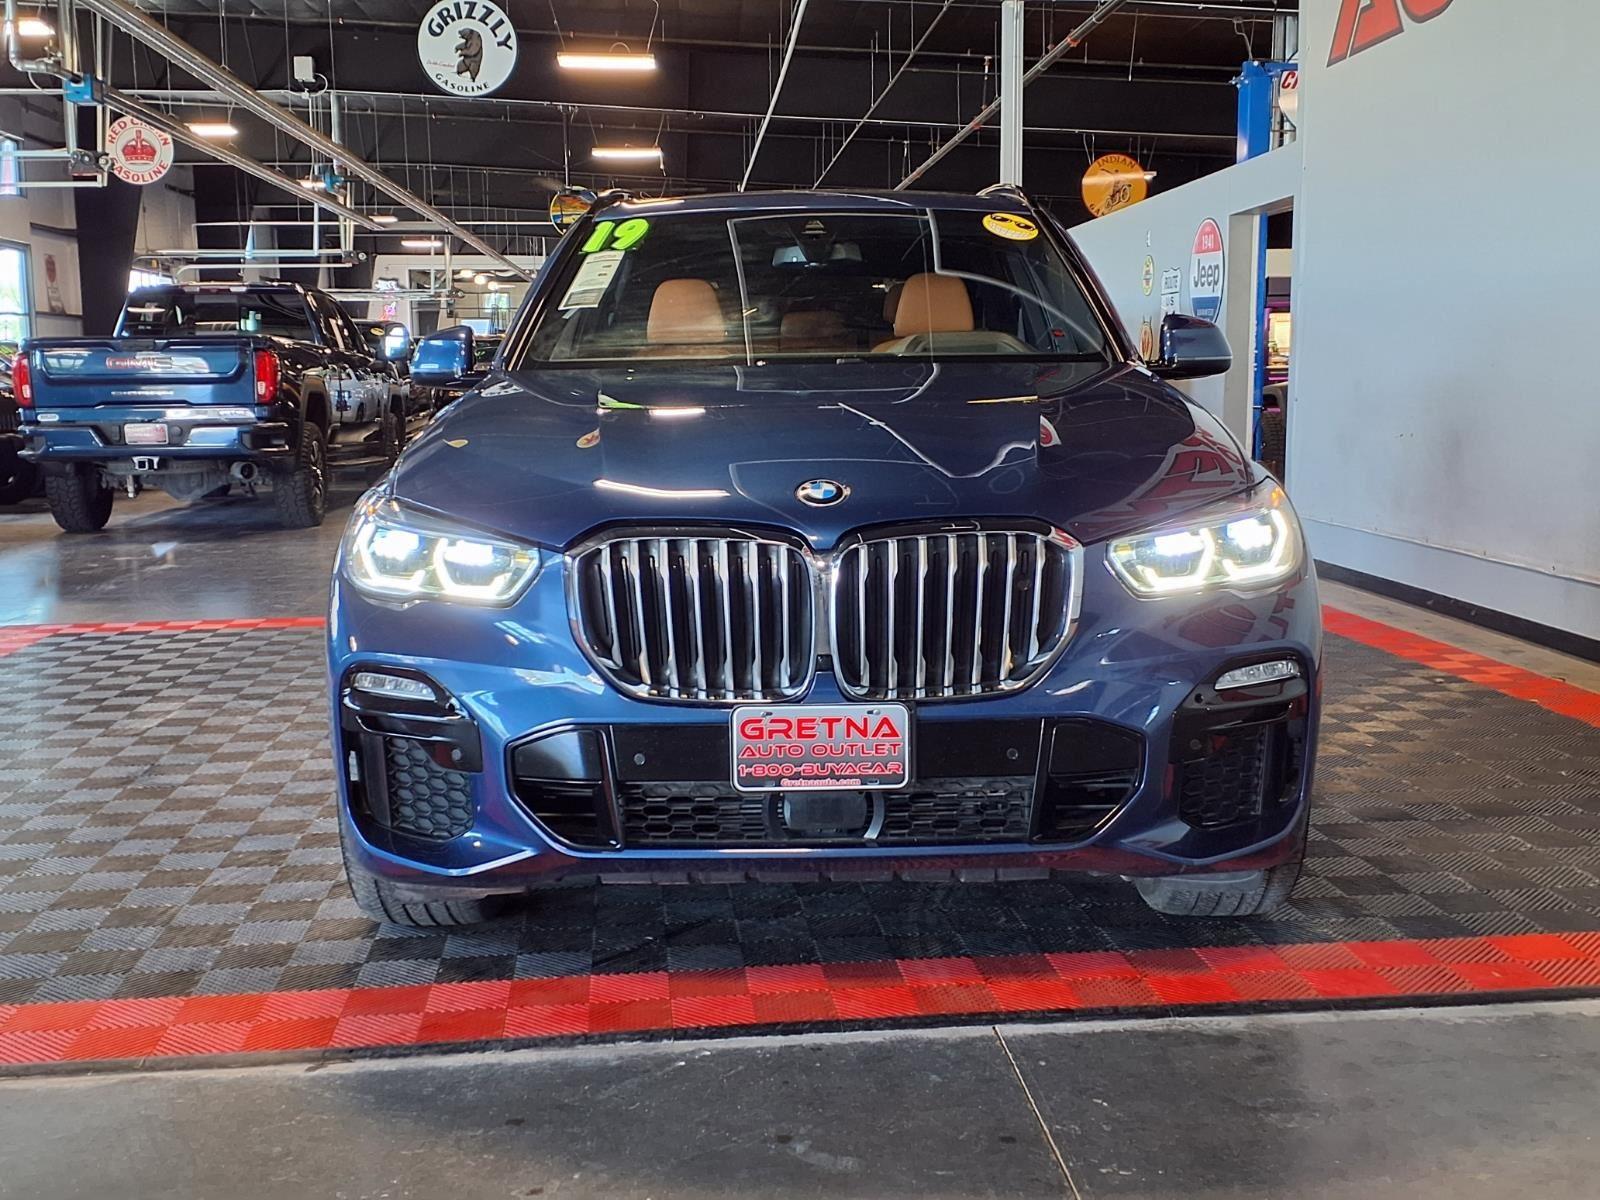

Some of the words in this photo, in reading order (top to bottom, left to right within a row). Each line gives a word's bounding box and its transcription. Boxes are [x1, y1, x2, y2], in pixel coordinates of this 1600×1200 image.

[428, 1, 513, 51] GRIZZLY
[435, 73, 490, 92] GASOLINE
[108, 120, 128, 145] RED
[1097, 155, 1136, 169] INDIAN
[581, 218, 649, 253] 19
[1193, 258, 1219, 292] Jeep
[739, 715, 901, 741] GRETNA
[738, 744, 805, 758] AUTO
[811, 743, 903, 757] OUTLET
[738, 762, 903, 777] 1-800-BUYACAR
